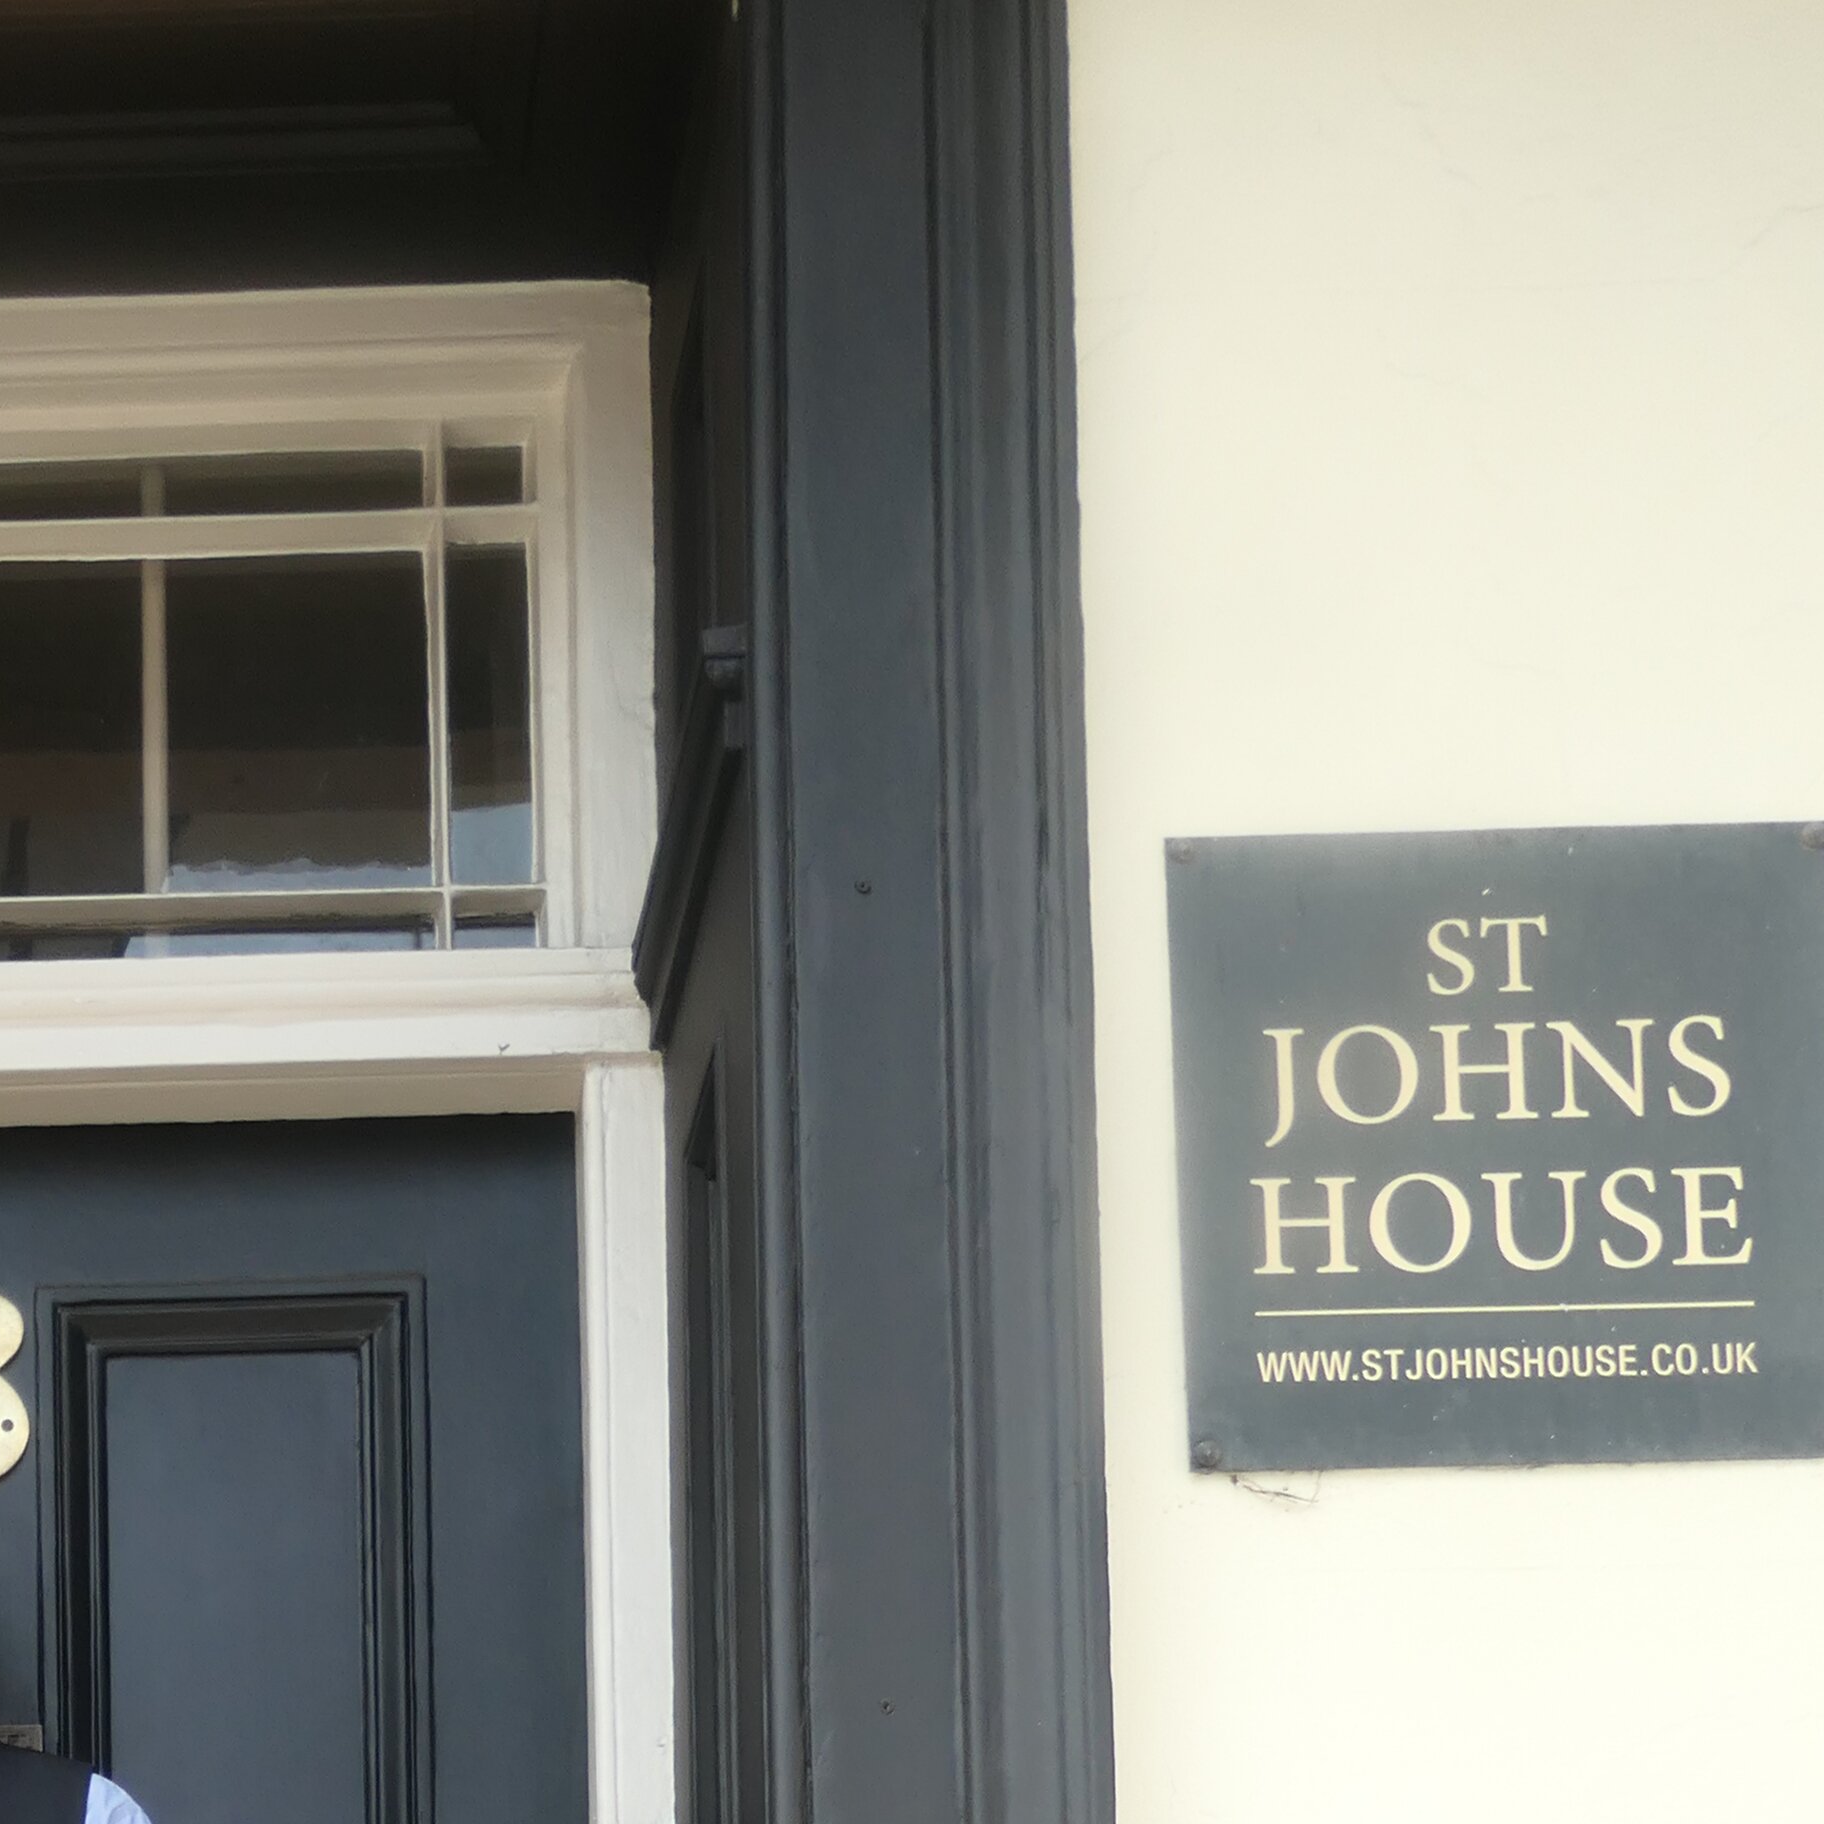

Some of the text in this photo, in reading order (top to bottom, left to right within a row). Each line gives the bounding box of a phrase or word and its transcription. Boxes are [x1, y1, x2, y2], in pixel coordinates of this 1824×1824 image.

[1427, 914, 1548, 996] ST
[1263, 1014, 1732, 1148] JOHNS
[1249, 1166, 1753, 1275] HOUSE
[1256, 1341, 1758, 1384] WWW.STJOHNSHOUSE.CO.UK
